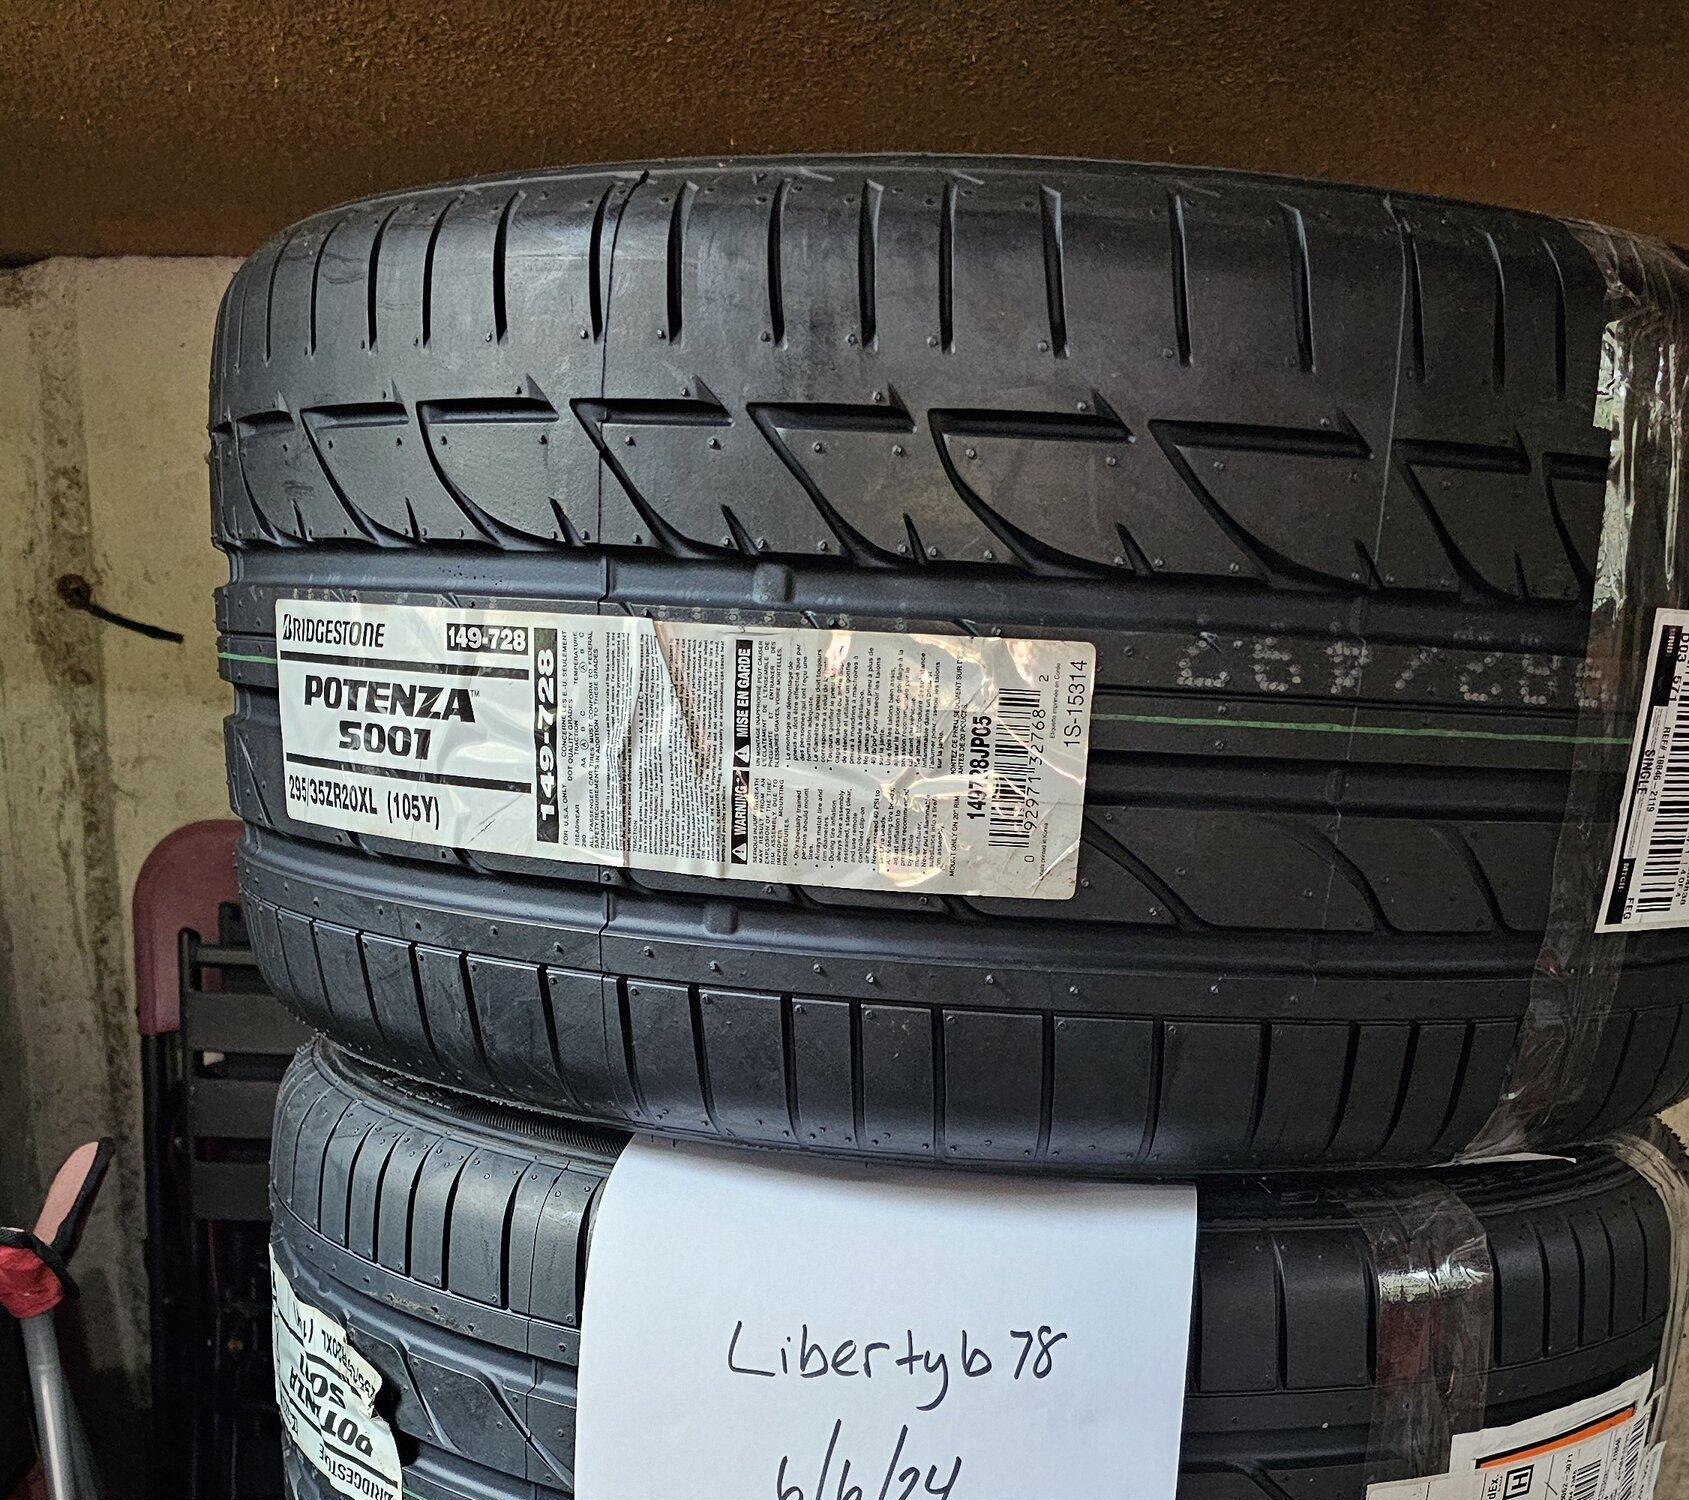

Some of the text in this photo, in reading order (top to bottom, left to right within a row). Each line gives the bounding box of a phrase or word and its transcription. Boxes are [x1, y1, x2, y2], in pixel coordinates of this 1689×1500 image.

[283, 614, 385, 648] BRIDGESTONE
[449, 627, 526, 651] 149-728
[304, 675, 475, 723] POTENZA
[736, 648, 750, 737] MISE EN GARDE
[1038, 673, 1049, 682] 2
[1063, 658, 1088, 748] 1S-15314
[538, 650, 555, 821] 149-728
[1028, 708, 1046, 765] 32768
[1636, 749, 1655, 795] SINGLE
[289, 775, 440, 830] 295/35ZR20XL (105Y)
[733, 785, 747, 836] WARNING
[1023, 776, 1041, 830] 92971
